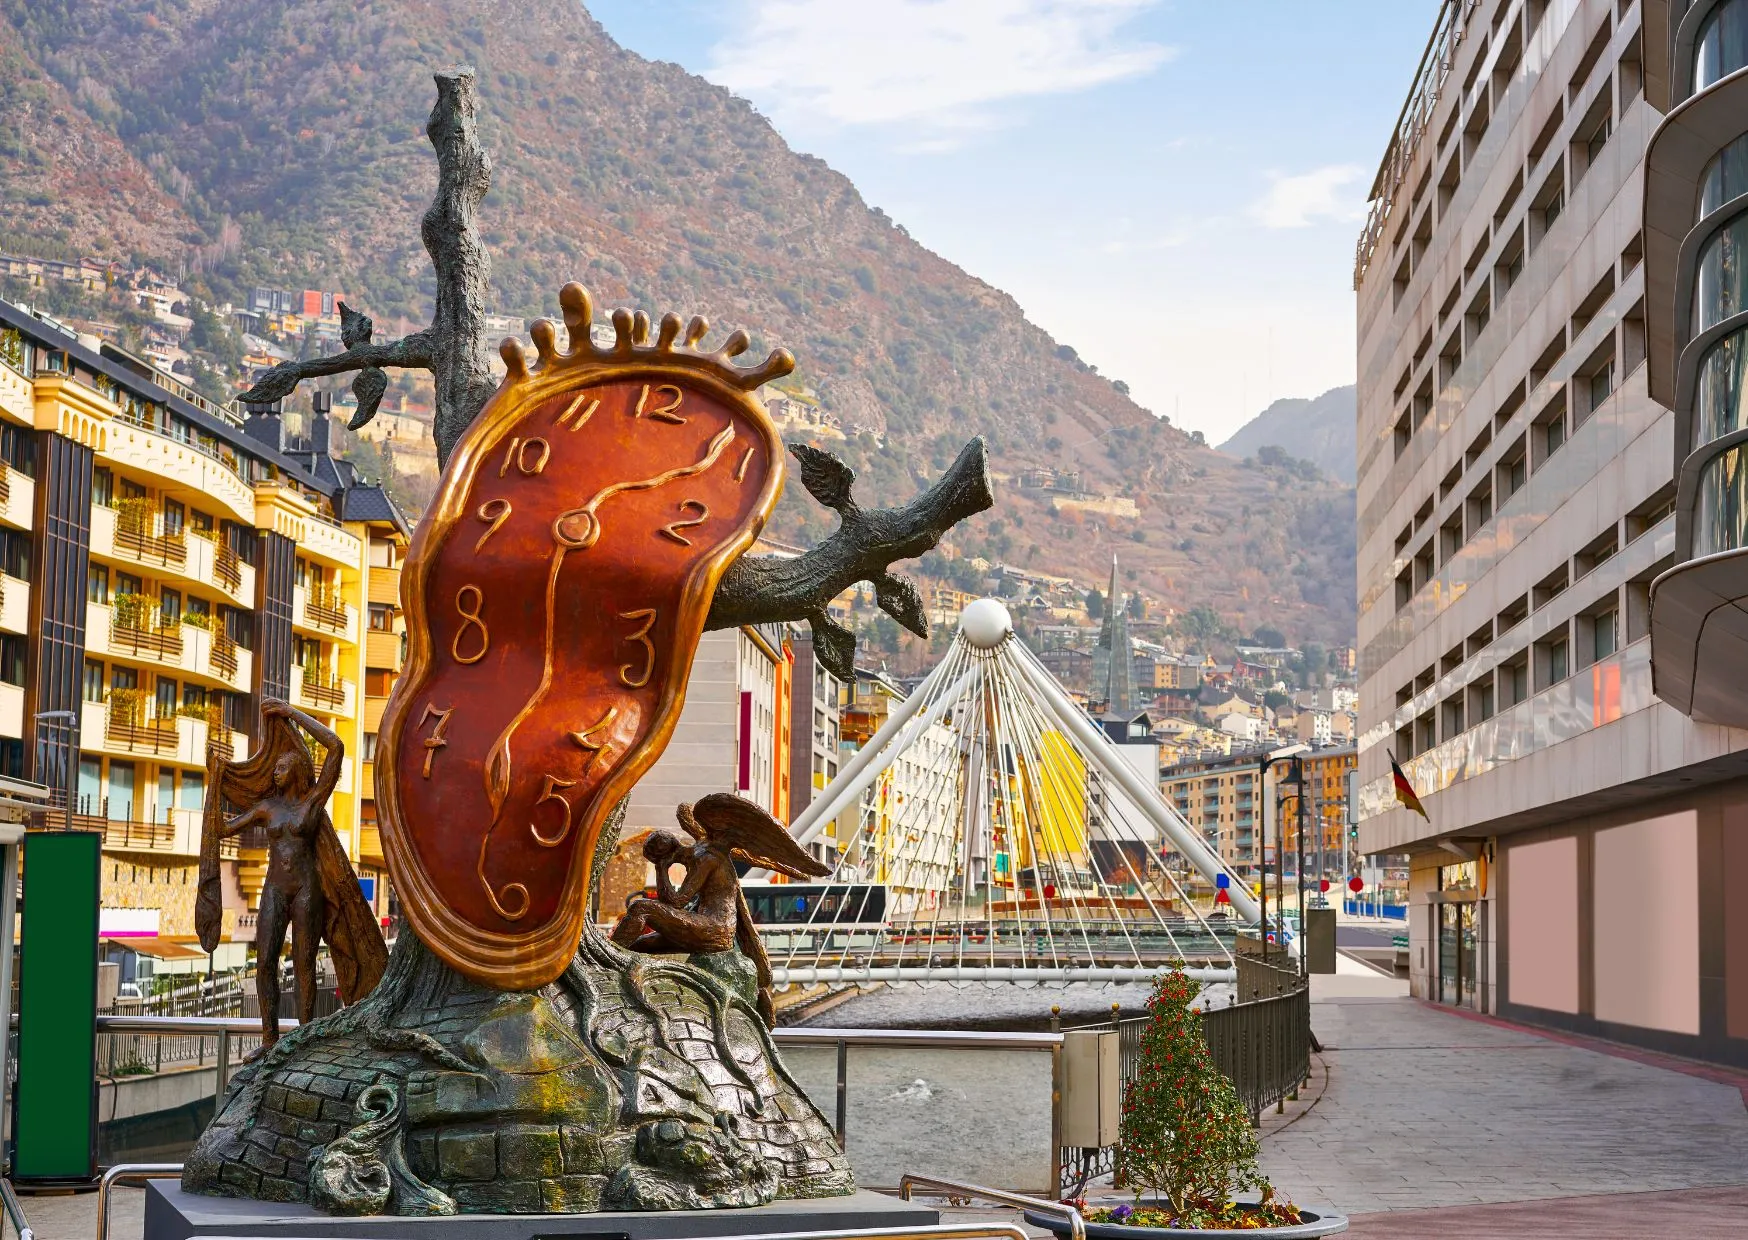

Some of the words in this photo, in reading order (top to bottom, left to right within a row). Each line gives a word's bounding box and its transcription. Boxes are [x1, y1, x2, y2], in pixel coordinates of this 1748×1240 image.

[554, 394, 600, 431] 11
[635, 384, 687, 424] 12
[500, 437, 550, 478] 10
[734, 447, 755, 484] 1
[474, 498, 512, 556] 9
[659, 499, 710, 546] 2
[452, 584, 489, 665] 8
[618, 608, 658, 688] 3
[417, 702, 455, 779] 7
[568, 706, 618, 777] 4
[530, 774, 577, 847] 5
[477, 834, 531, 921] 6
